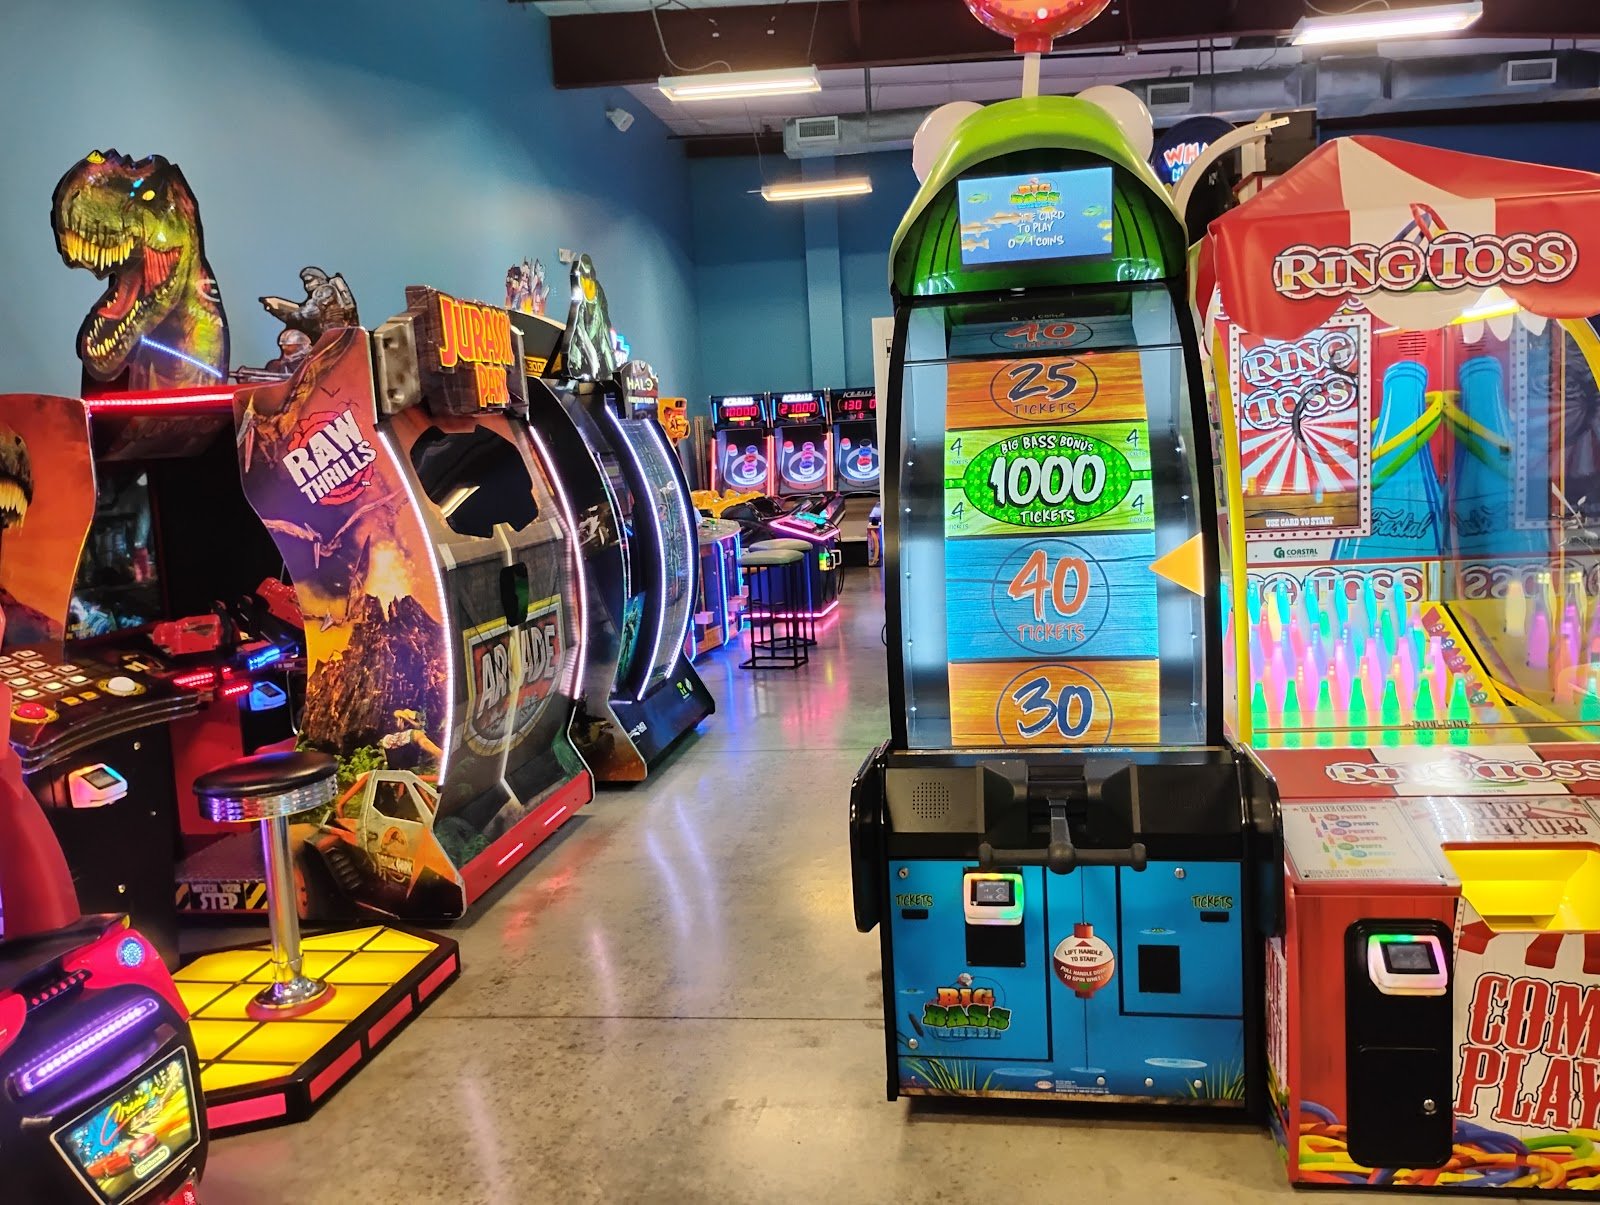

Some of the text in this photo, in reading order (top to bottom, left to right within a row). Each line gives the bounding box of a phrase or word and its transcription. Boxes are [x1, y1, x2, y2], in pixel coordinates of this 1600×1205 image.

[1038, 210, 1065, 220] CARD
[1017, 221, 1055, 233] TO PLAY
[1035, 235, 1065, 247] COINS
[1274, 239, 1569, 293] RING TOSS
[1004, 322, 1077, 343] 40
[1242, 337, 1351, 383] RING
[475, 361, 510, 408] PARK
[626, 376, 654, 391] HALO
[1007, 360, 1078, 403] 25
[1014, 402, 1077, 415] TICKETS
[1245, 379, 1351, 425] TOSS
[282, 409, 364, 487] RAW
[950, 437, 963, 457] 4
[1001, 435, 1093, 454] BIG BASS BONUS
[1126, 428, 1139, 448] 4
[300, 440, 377, 504] THRILLS
[989, 454, 1107, 506] 1000
[951, 501, 964, 520] 4
[1131, 493, 1145, 513] 4
[1019, 508, 1077, 524] TICKETS
[1265, 516, 1335, 528] USE CARD TO START
[1286, 548, 1318, 556] COASTAL
[1007, 549, 1091, 623] 40
[1017, 623, 1086, 643] TICKETS
[1011, 676, 1094, 739] 30
[1473, 761, 1600, 780] TOSS
[1531, 817, 1588, 835] UP!
[200, 892, 238, 910] STEP
[895, 893, 934, 908] TICKETS
[1191, 894, 1233, 909] TICKETS
[1063, 948, 1104, 957] LIFT HANDLE
[1060, 965, 1072, 974] PULL
[936, 986, 996, 1008] BIG
[921, 1003, 1012, 1031] BASS
[136, 1147, 169, 1176] Nintendo
